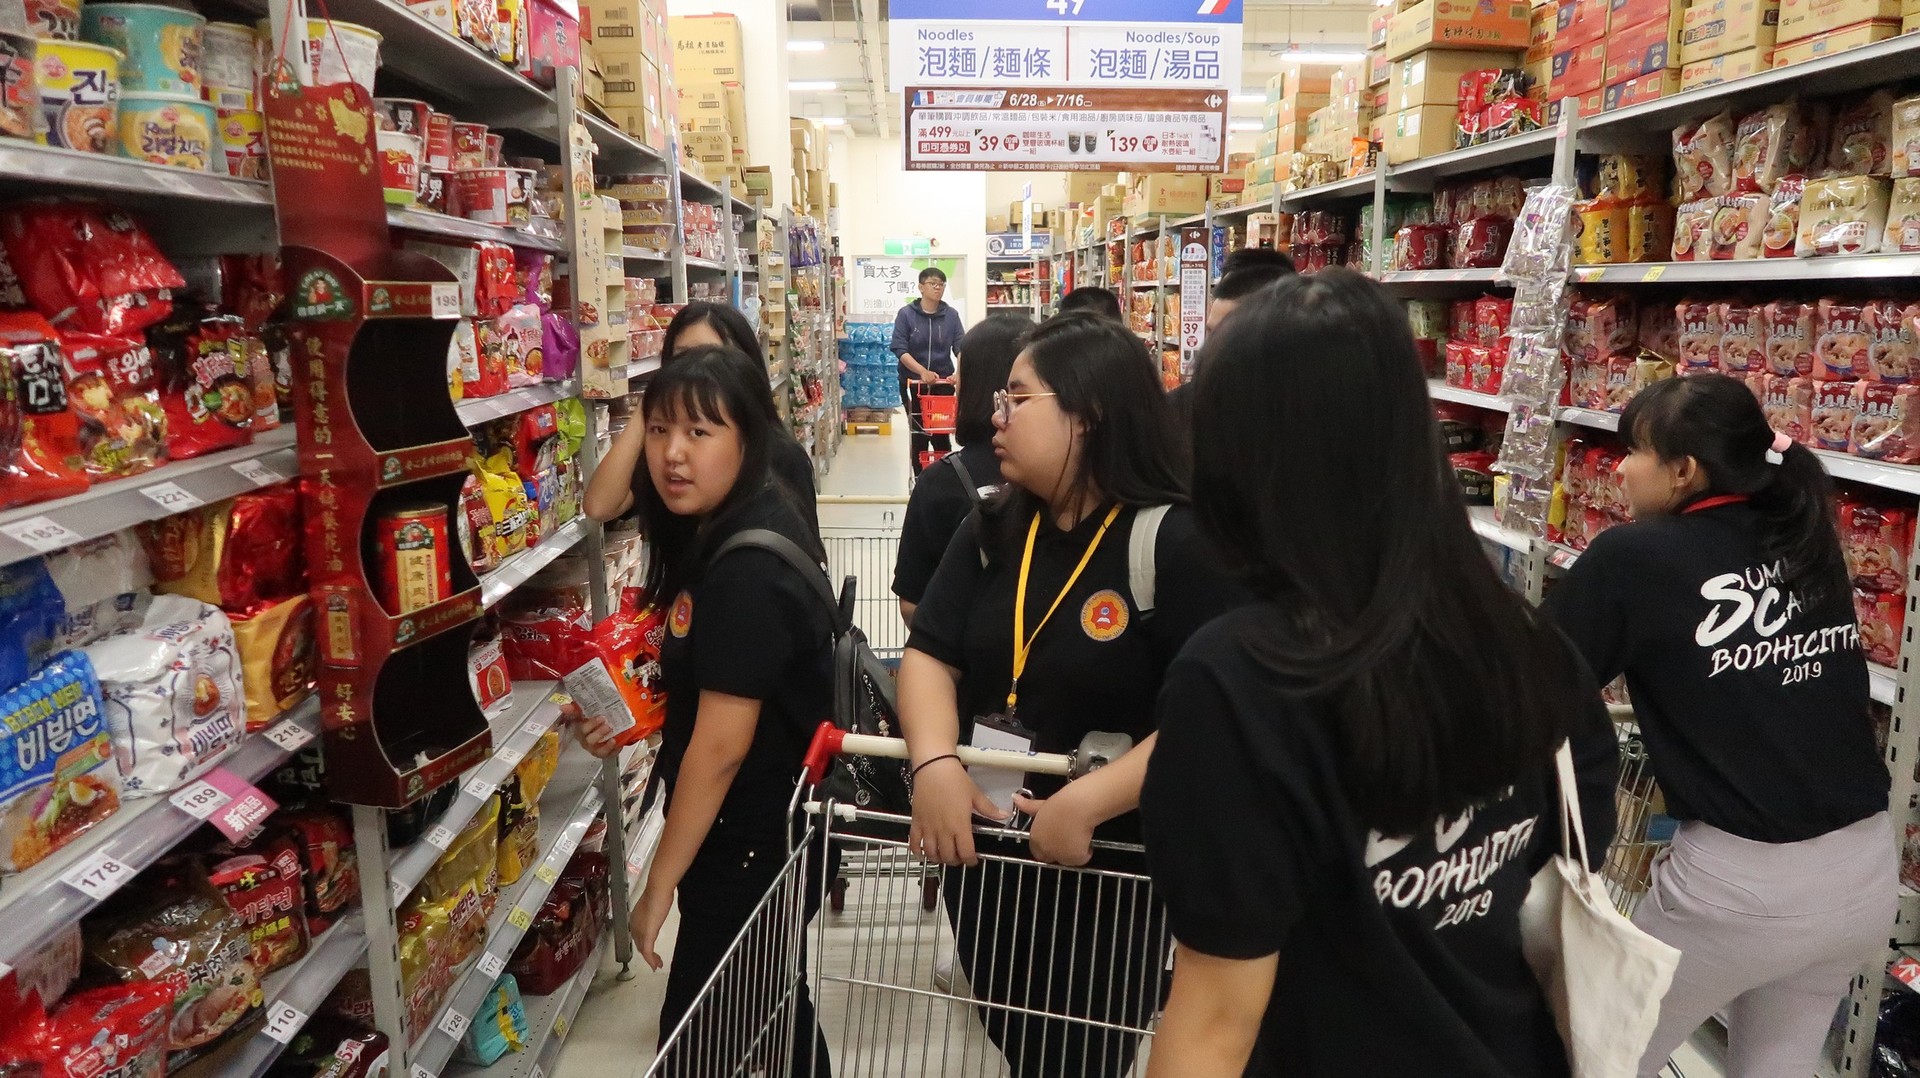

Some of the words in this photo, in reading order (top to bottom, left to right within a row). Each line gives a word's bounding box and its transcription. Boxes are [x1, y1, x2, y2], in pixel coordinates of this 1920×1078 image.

[918, 28, 974, 41] Noodles
[1126, 31, 1220, 45] Noodles/Soup
[918, 46, 1051, 79] 泡麵/麵條
[1089, 48, 1220, 80] 泡麵/湯品
[1009, 93, 1038, 107] 6/28
[1056, 94, 1084, 107] 7/16
[979, 135, 999, 151] 39
[1109, 136, 1139, 152] 139
[863, 266, 902, 279] 買太多
[884, 281, 916, 294] 了嗎?
[436, 294, 459, 307] 198
[1183, 323, 1199, 335] 39
[160, 490, 189, 505] 221
[20, 525, 66, 542] 183
[1708, 622, 1861, 678] BODHICITTA
[1782, 661, 1822, 686] 2019
[273, 723, 302, 743] 218
[470, 780, 487, 794] 149
[182, 788, 220, 811] 189
[430, 828, 448, 845] 218
[81, 861, 121, 890] 178
[1434, 889, 1493, 930] 2019
[484, 956, 501, 974] 177
[271, 1008, 297, 1035] 110
[446, 1013, 465, 1033] 128
